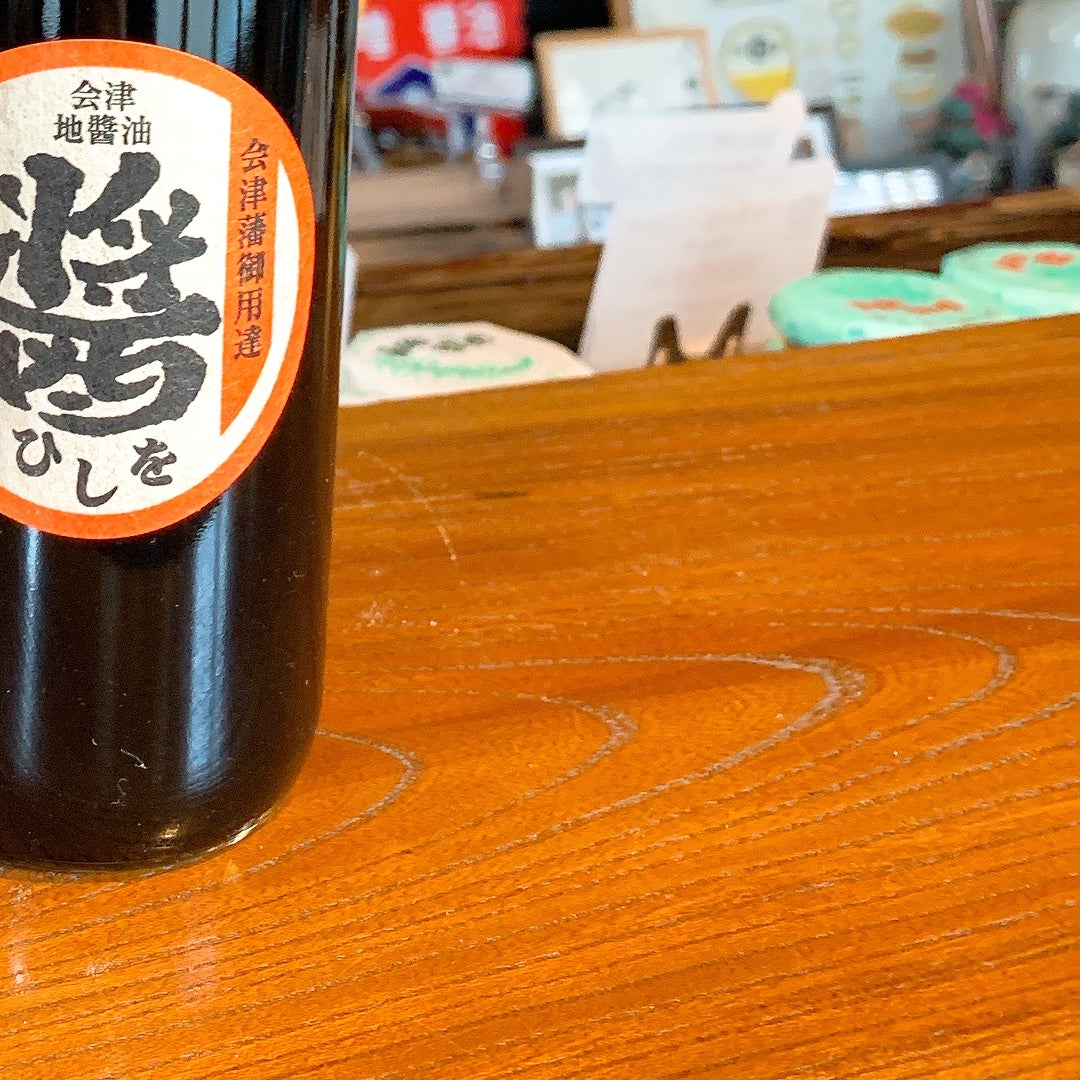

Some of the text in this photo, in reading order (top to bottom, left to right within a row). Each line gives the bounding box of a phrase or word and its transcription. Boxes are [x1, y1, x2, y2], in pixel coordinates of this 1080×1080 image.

[70, 80, 138, 111] 会津
[233, 137, 270, 361] 会津藩御用達
[12, 427, 178, 508] ひしを
